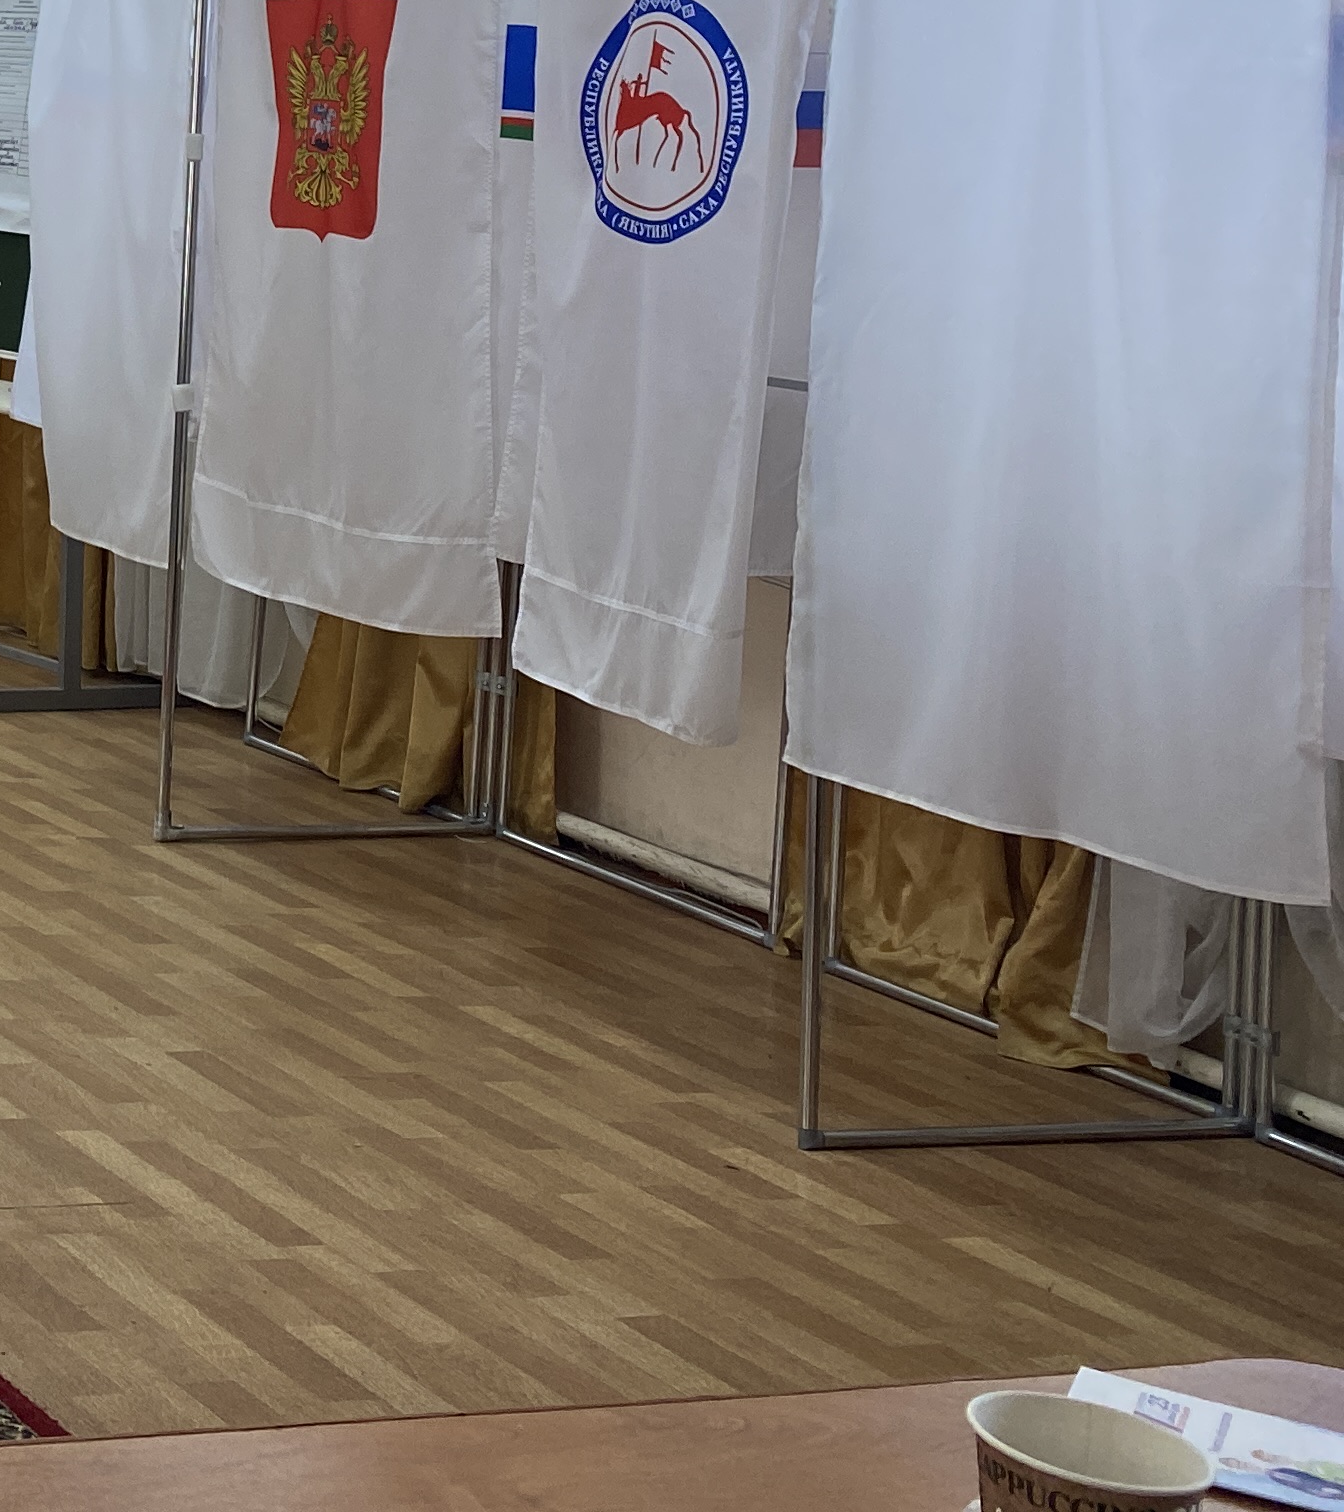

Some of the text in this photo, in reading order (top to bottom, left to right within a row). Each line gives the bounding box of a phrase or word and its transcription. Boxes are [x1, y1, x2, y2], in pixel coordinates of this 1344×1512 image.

[584, 56, 610, 179] РЕСПУБЛИКА
[679, 46, 745, 230] САХА РЕСПУБЛИКАТА
